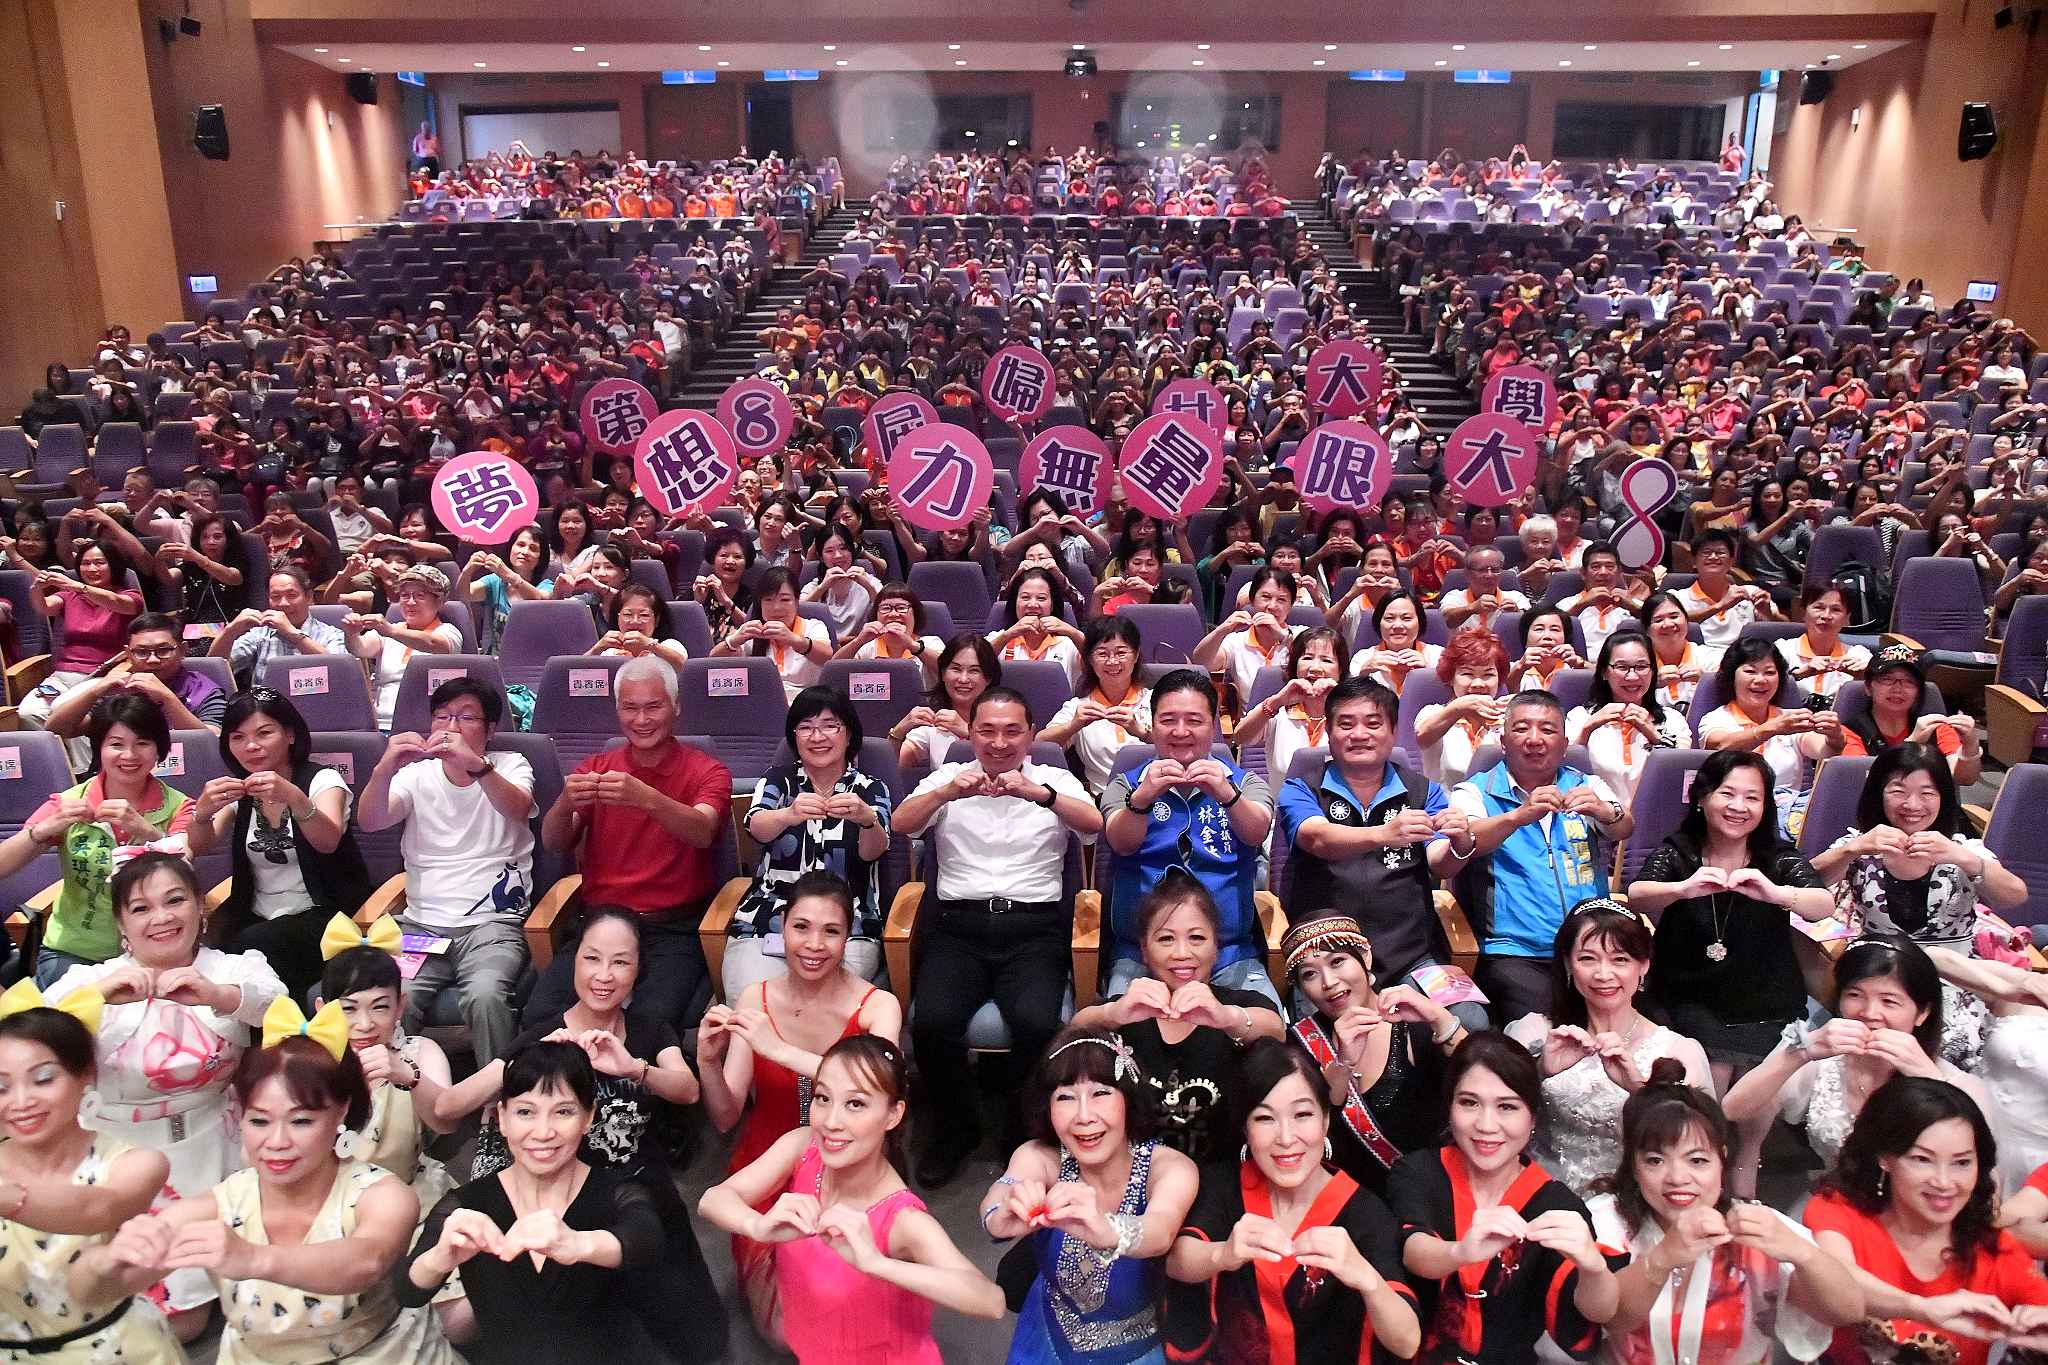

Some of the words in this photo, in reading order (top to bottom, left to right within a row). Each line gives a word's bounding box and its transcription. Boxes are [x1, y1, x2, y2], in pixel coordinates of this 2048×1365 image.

[989, 352, 1048, 415] 婦
[1317, 353, 1370, 406] 大
[1495, 375, 1546, 428] 學
[591, 389, 649, 448] 第
[732, 389, 780, 450] 8
[643, 418, 731, 514] 想
[898, 440, 976, 521] 力
[1033, 437, 1103, 513] 無
[1121, 419, 1212, 516] 量
[1302, 430, 1378, 509] 限
[1453, 428, 1524, 495] 大
[440, 461, 528, 533] 夢
